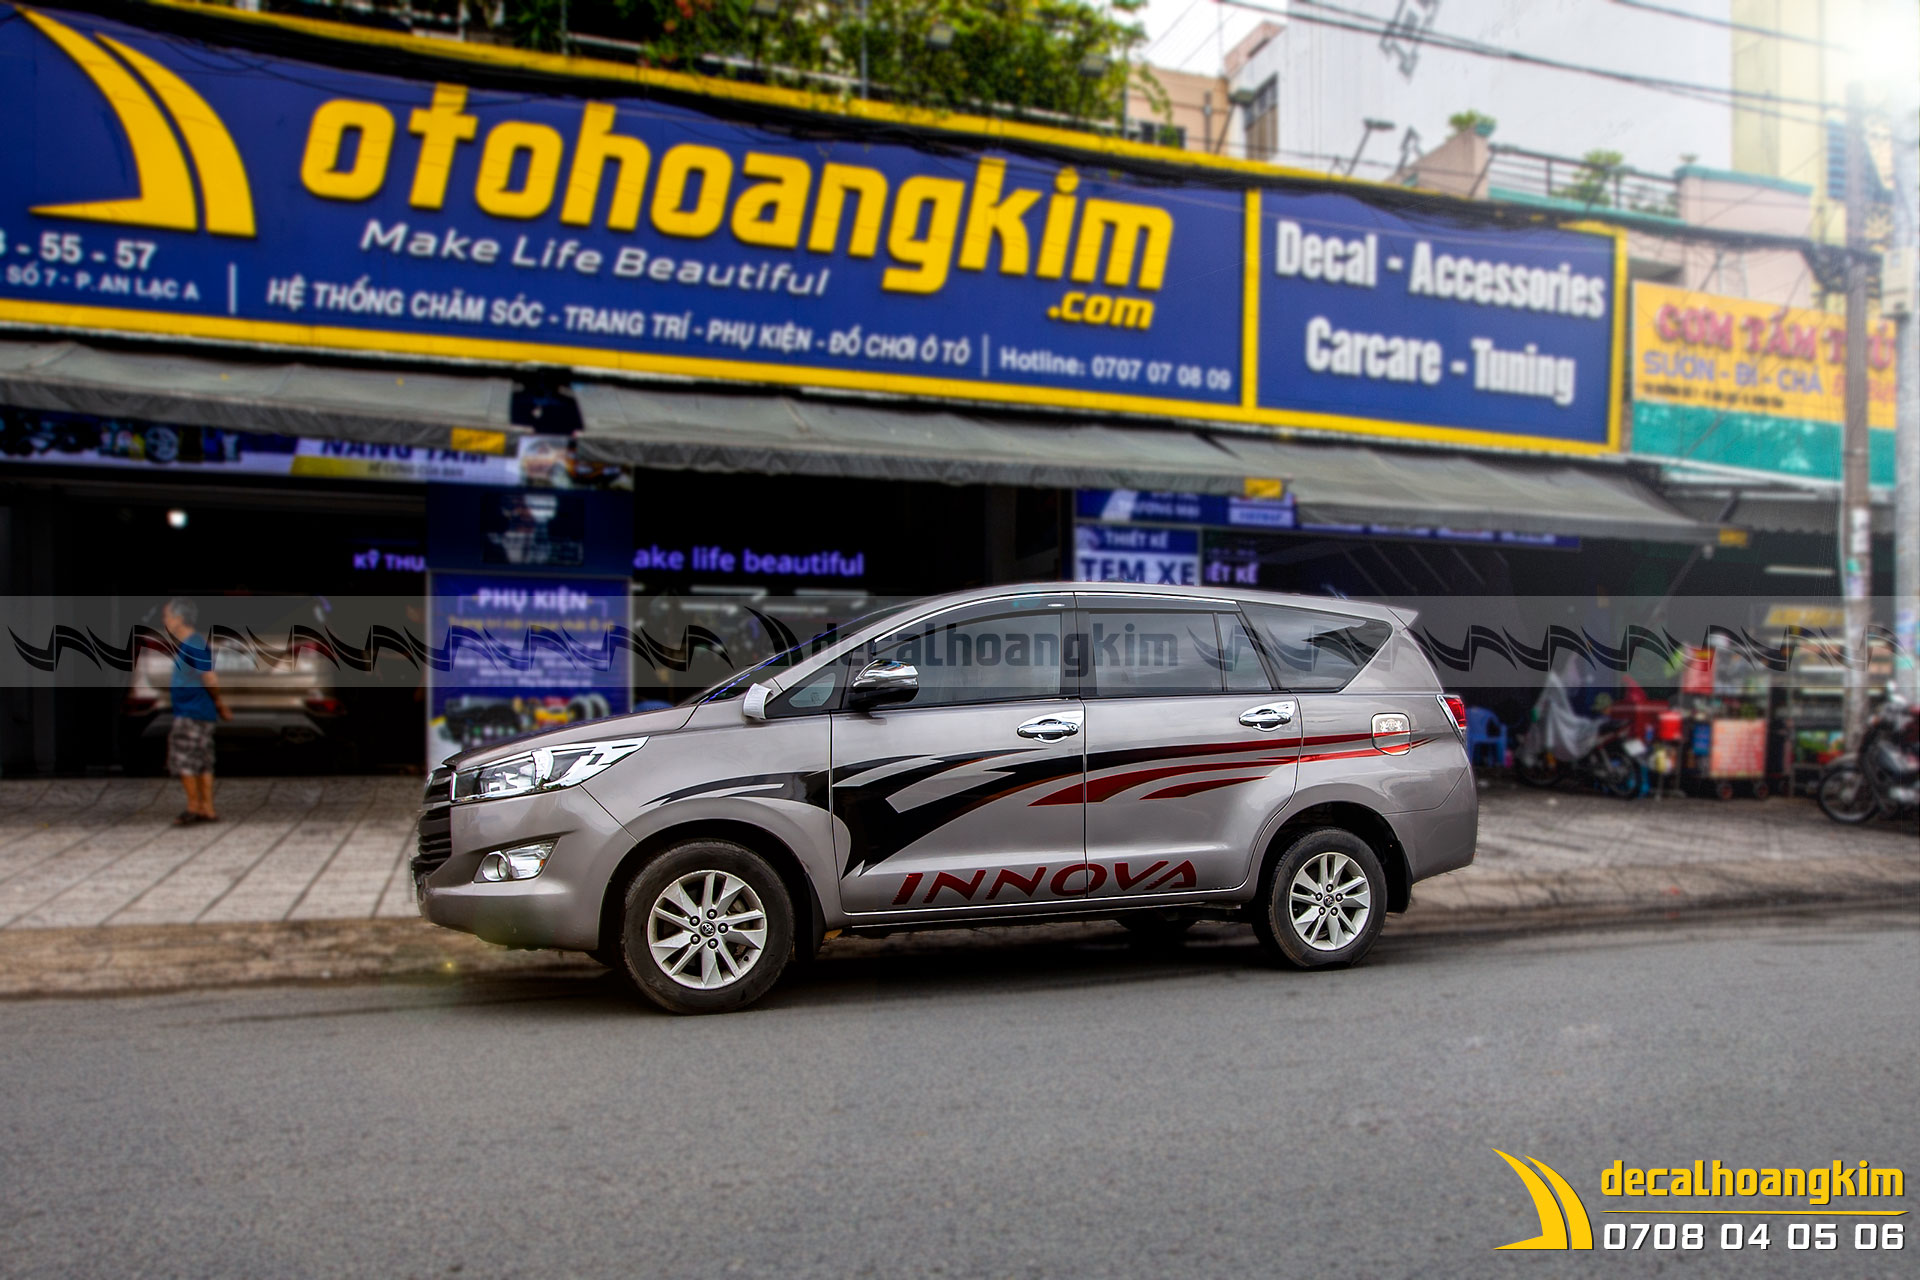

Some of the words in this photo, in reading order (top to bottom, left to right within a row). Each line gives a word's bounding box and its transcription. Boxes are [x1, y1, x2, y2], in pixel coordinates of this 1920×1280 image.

[300, 82, 1174, 294] otohoangkim
[40, 232, 83, 263] 55
[115, 239, 157, 270] 57
[359, 220, 501, 263] Make
[511, 235, 604, 273] Life
[613, 246, 831, 296] Beautiful
[1275, 219, 1378, 287] Decal
[1409, 241, 1606, 318] Accessories
[45, 268, 58, 287] 7
[184, 282, 200, 300] A
[266, 274, 306, 311] HỆ
[313, 274, 405, 316] THỐNG
[410, 288, 485, 322] CHĂM
[490, 294, 544, 328] SÓC
[564, 305, 645, 336] TRANG
[651, 311, 692, 341] TRÍ
[706, 319, 755, 351] PHỤ
[759, 321, 813, 354] KIỆN
[920, 334, 938, 362] Ô
[942, 336, 971, 366] TÔ
[1047, 290, 1155, 329] .com
[1000, 347, 1086, 376] Hotline:
[1092, 356, 1142, 381] 0707
[1147, 361, 1172, 383] 07
[1177, 364, 1202, 387] 08
[1206, 368, 1232, 391] 09
[1305, 316, 1443, 384] Carcare
[1471, 338, 1576, 406] Tuning
[691, 545, 736, 573] life
[743, 548, 865, 577] beautiful
[1079, 557, 1145, 583] TEM
[1157, 560, 1196, 587] XE
[477, 587, 527, 613] PHỤ
[534, 586, 588, 614] KIỆN
[891, 860, 1197, 905] INNOVA
